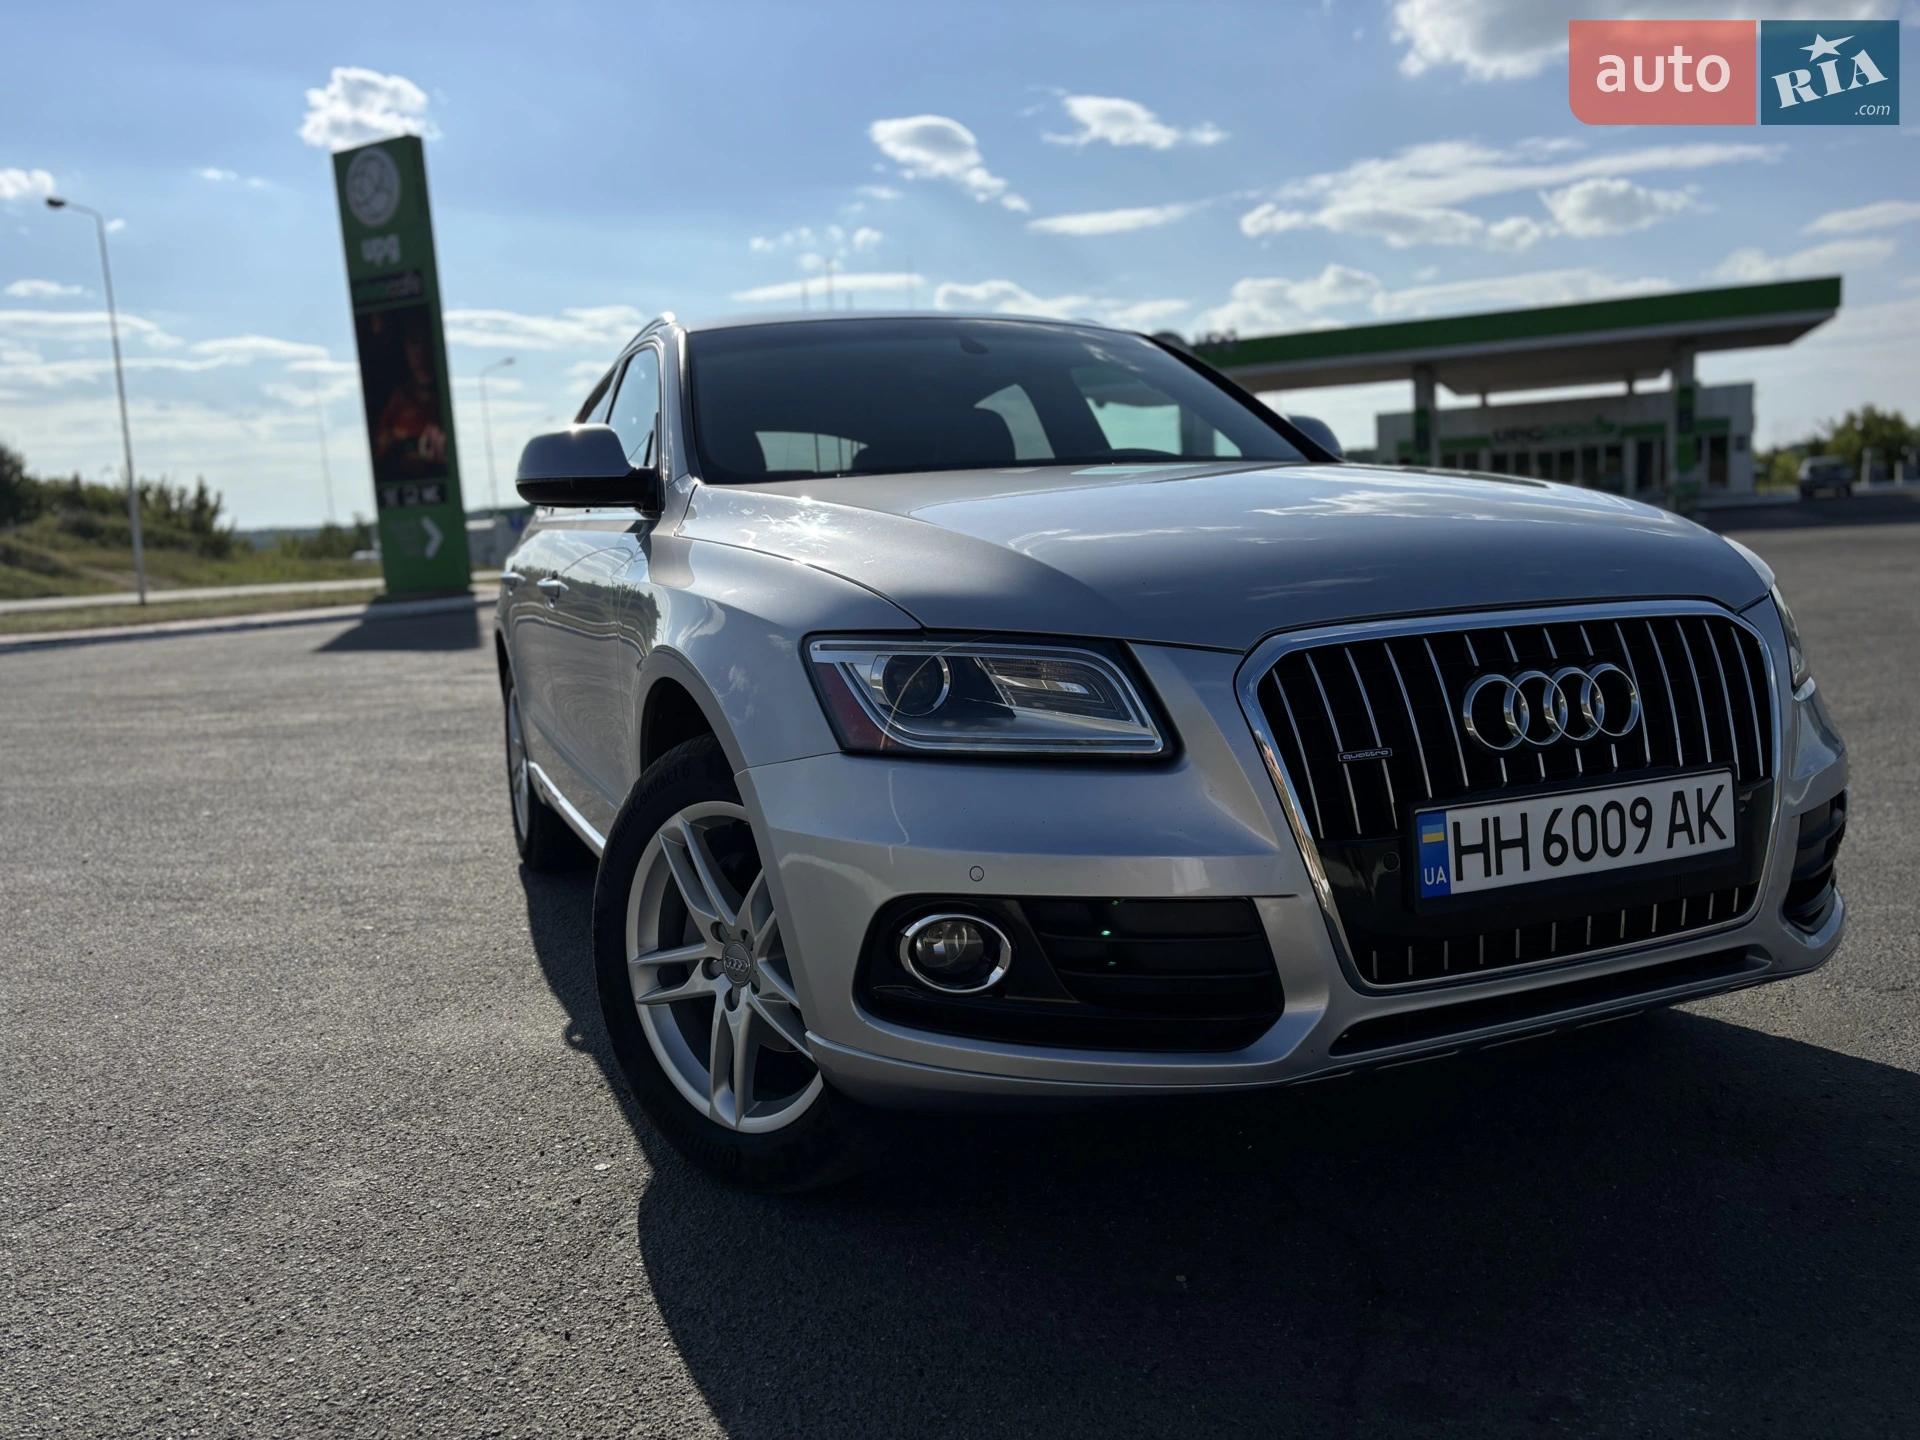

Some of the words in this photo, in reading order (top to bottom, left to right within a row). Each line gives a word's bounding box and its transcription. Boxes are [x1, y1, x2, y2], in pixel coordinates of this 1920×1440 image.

[1342, 749, 1389, 760] quattro
[1452, 812, 1531, 882] HH
[1542, 796, 1653, 867] 6009
[1666, 784, 1728, 849] AK
[1424, 866, 1447, 886] UA
